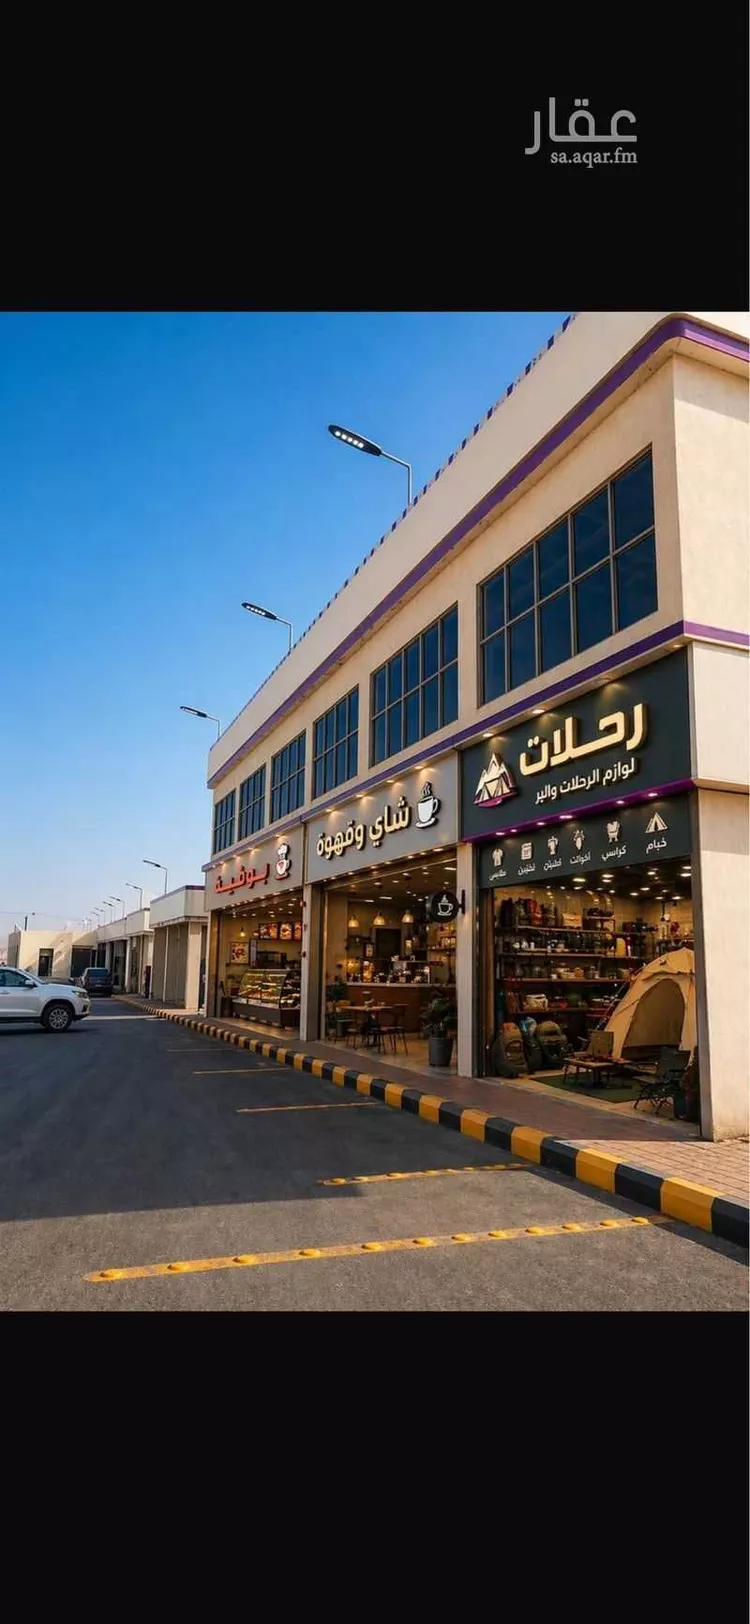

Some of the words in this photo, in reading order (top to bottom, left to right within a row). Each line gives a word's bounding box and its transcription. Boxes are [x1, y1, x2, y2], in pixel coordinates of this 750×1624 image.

[519, 703, 644, 777] رحلات
[559, 768, 600, 794] الرحلات
[602, 757, 635, 786] لوازم
[535, 783, 558, 805] والبر
[369, 796, 410, 848] شاي
[316, 820, 365, 860] وقهوة
[601, 845, 627, 862] كراسي
[645, 837, 667, 854] خيام
